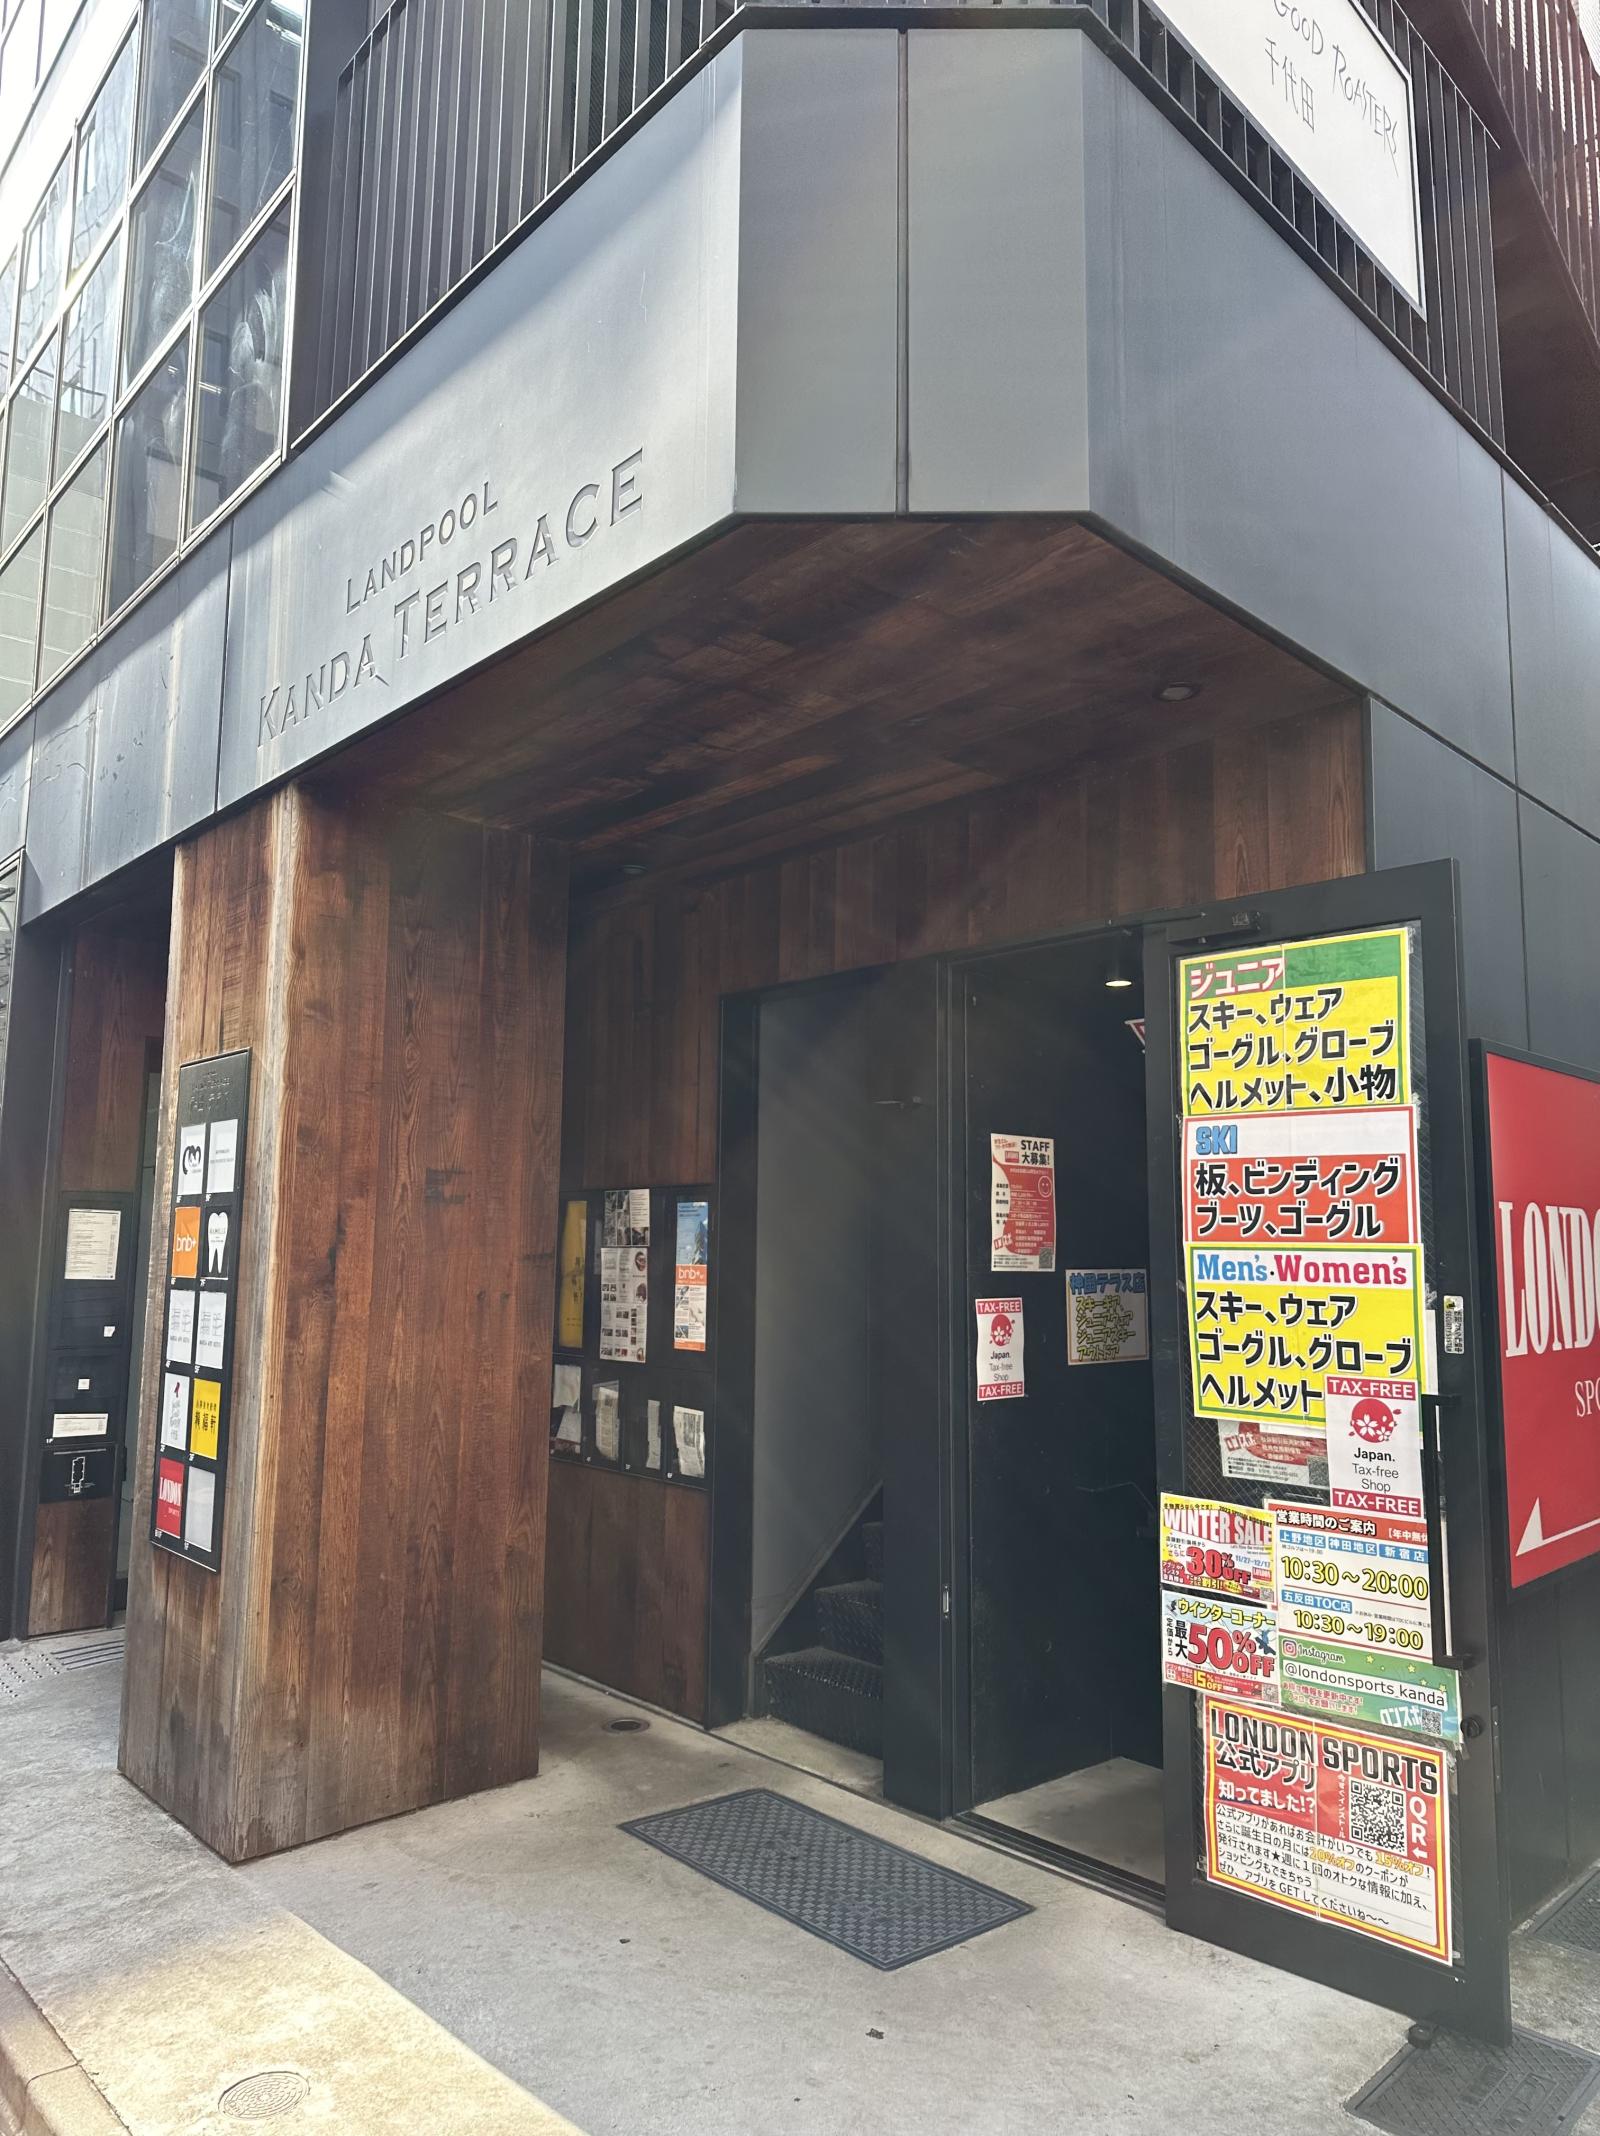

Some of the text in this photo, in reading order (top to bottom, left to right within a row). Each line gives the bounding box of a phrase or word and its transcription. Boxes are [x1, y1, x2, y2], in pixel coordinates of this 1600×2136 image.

[346, 481, 498, 616] LANDPOOL
[257, 447, 643, 748] KANDA TERRACE
[1190, 957, 1286, 999] ジュニア
[1188, 987, 1343, 1033] スキー、ウェア
[1189, 1019, 1394, 1072] ゴーグル、グローブ
[1190, 1064, 1397, 1110] ヘルメット、小物
[1021, 1140, 1050, 1152] STAFF
[1195, 1124, 1238, 1155] SKI
[1195, 1157, 1399, 1197] 板、ビンディング
[1196, 1199, 1382, 1238] ブーツ、ゴーグル
[1070, 1272, 1145, 1295] 神田テラス店
[1498, 1201, 1600, 1358] LOND
[978, 1302, 1020, 1312] TAX-FREE
[1196, 1291, 1357, 1328] スキー、ウェア
[1197, 1328, 1413, 1375] ゴーグル、グローブ
[980, 1384, 1022, 1397] TAX-FREE
[1202, 1372, 1323, 1413] ヘルメット
[1329, 1379, 1414, 1399] TAX-FREE
[1352, 1463, 1399, 1479] Tax-free
[1361, 1479, 1391, 1493] Shop
[1334, 1491, 1419, 1516] TAX-FREE
[1164, 1509, 1272, 1545] WINTER SALE
[1276, 1509, 1377, 1536] 営業時間のご案内
[1281, 1531, 1325, 1547] 上野地区
[1329, 1537, 1376, 1555] 神田地区
[1186, 1546, 1234, 1578] 30%
[1222, 1567, 1251, 1584] OFF
[1178, 1598, 1276, 1629] ウインターコーナー
[1284, 1591, 1350, 1612] 五反田TOC店
[1175, 1620, 1187, 1659] 最大
[1188, 1623, 1256, 1670] 50%
[1232, 1652, 1274, 1677] OFF
[1298, 1644, 1345, 1664] Instagram
[1207, 1683, 1223, 1692] OFF
[1285, 1662, 1445, 1707] @londonsports_kanda
[1211, 1709, 1438, 1795] LONDON SPORTS
[1216, 1741, 1315, 1790] 公式アプリ
